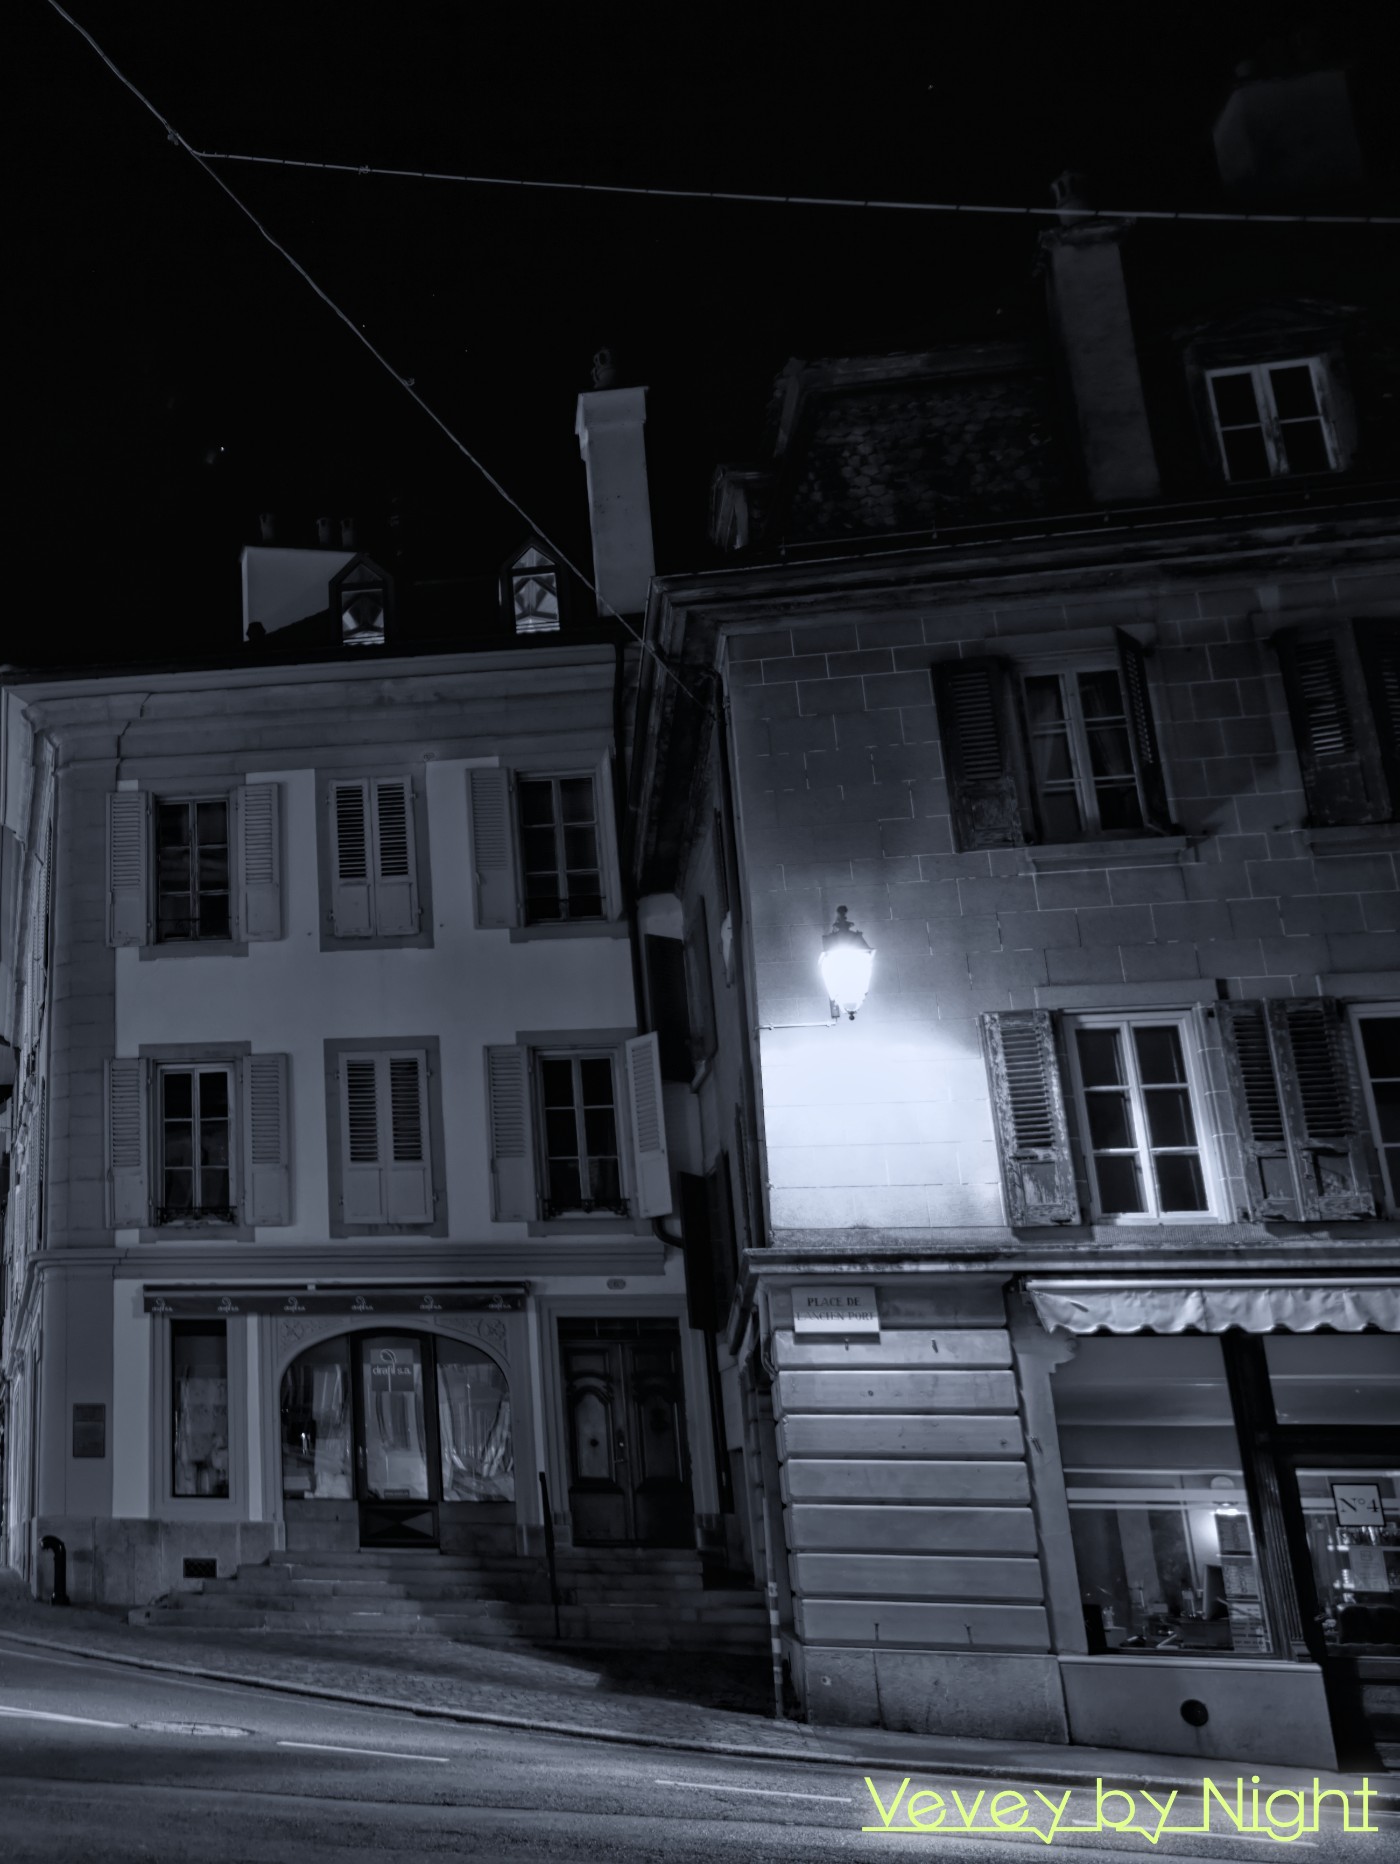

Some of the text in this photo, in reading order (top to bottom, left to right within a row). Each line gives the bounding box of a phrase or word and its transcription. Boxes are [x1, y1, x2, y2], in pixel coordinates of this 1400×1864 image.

[807, 1297, 861, 1307] PLACE DE
[848, 1311, 874, 1321] PORT
